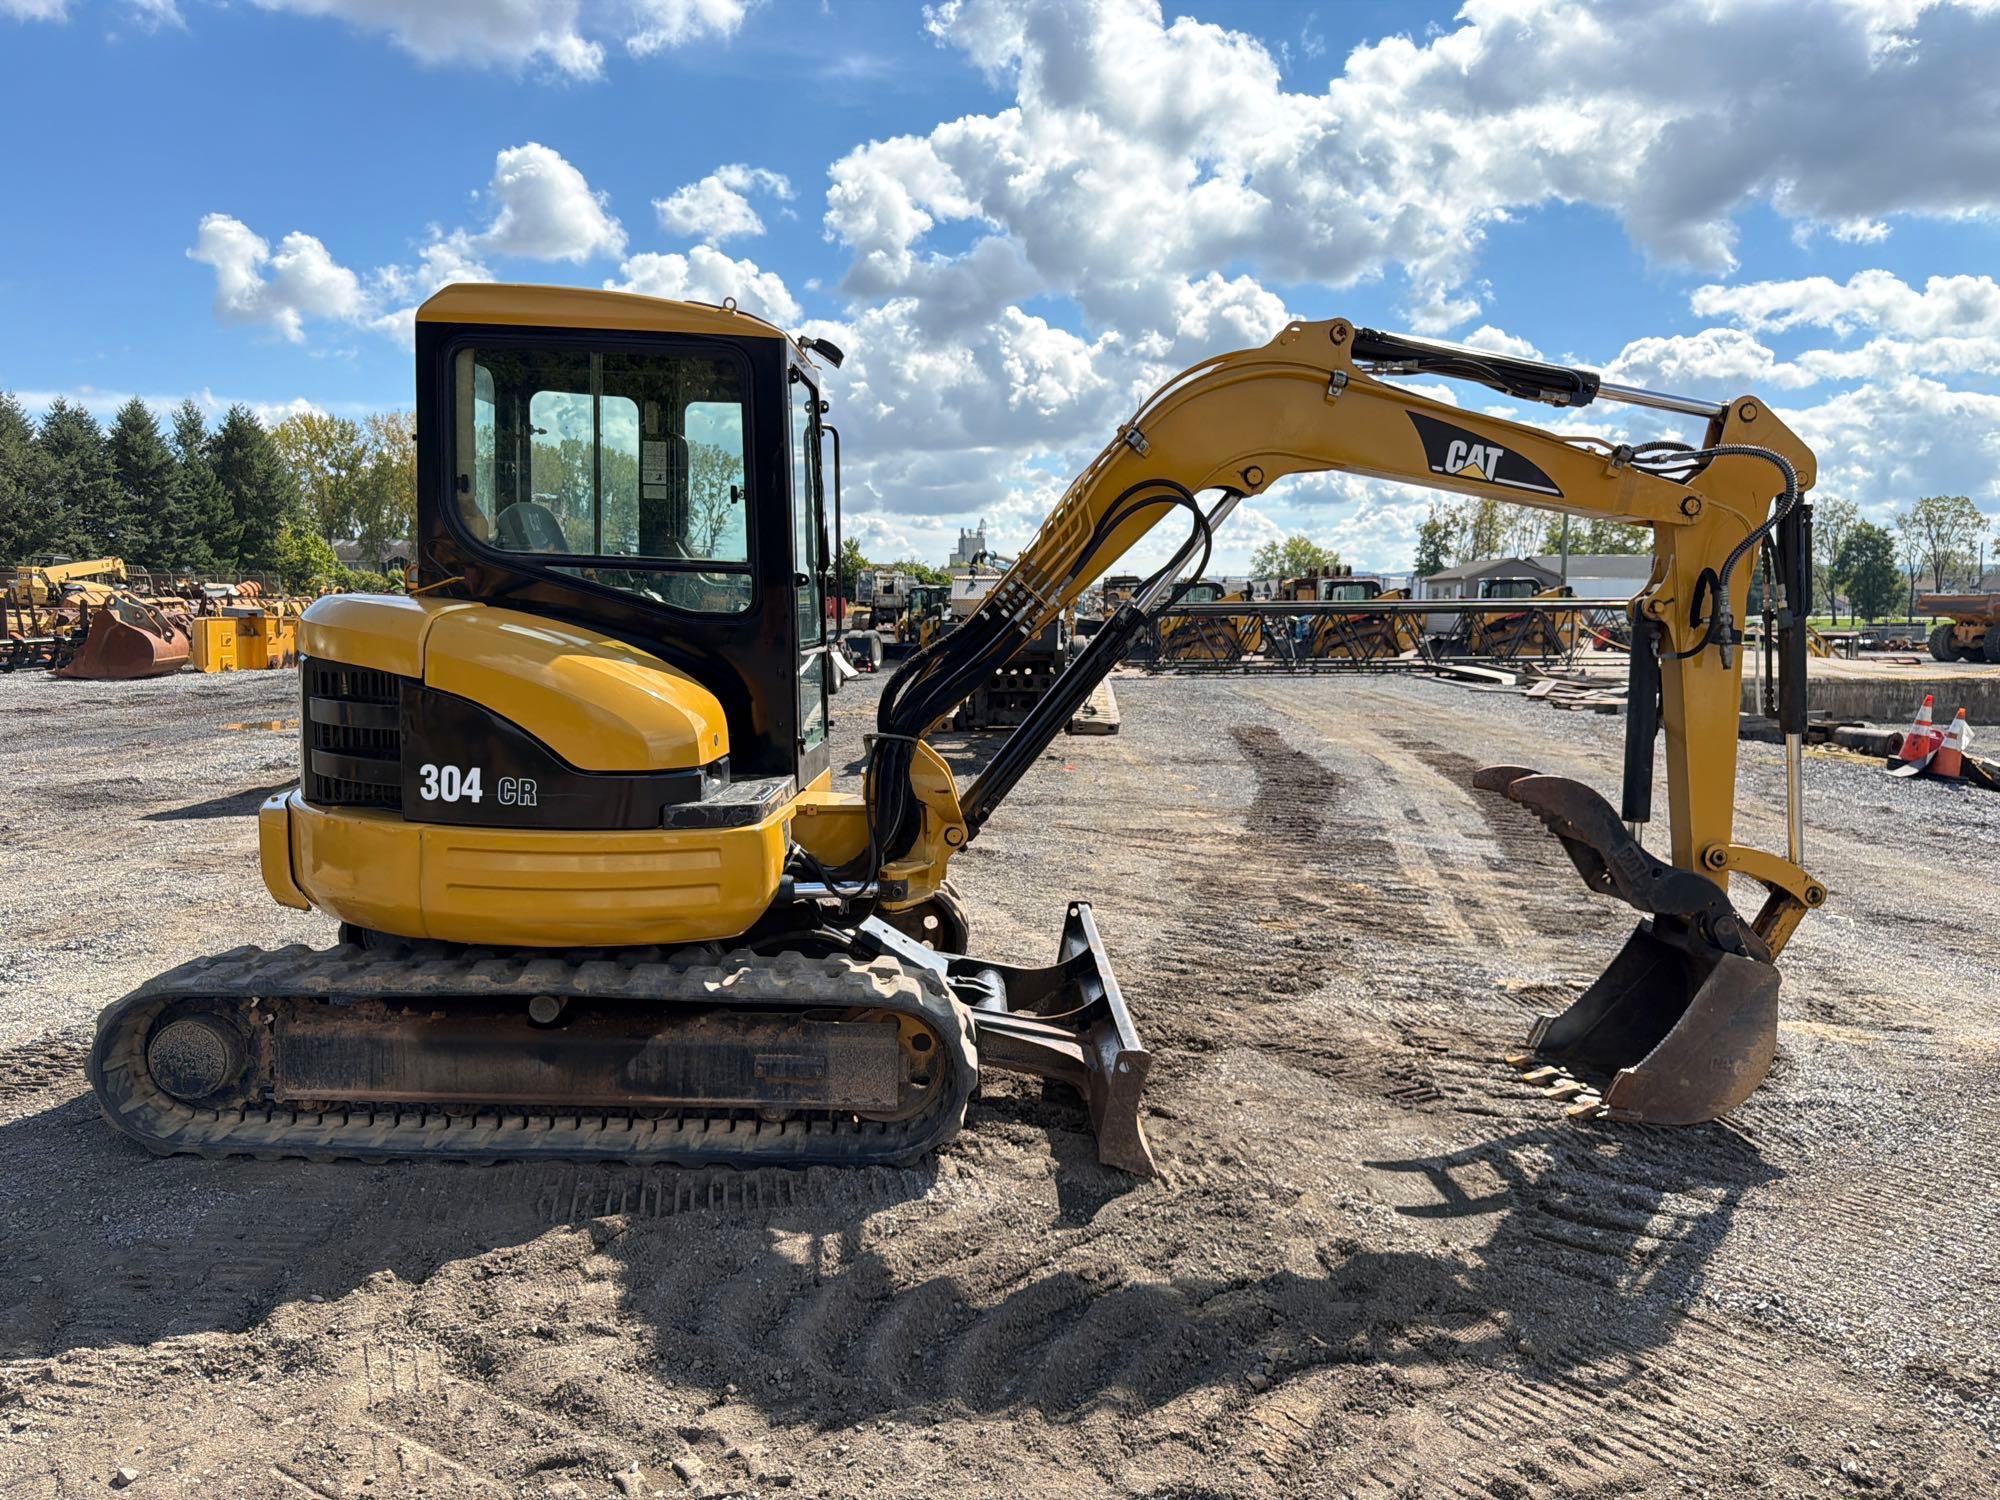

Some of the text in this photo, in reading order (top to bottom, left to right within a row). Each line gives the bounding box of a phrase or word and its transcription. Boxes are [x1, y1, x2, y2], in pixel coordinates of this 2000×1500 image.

[1445, 440, 1504, 481] CAT
[420, 764, 537, 806] 304 CR
